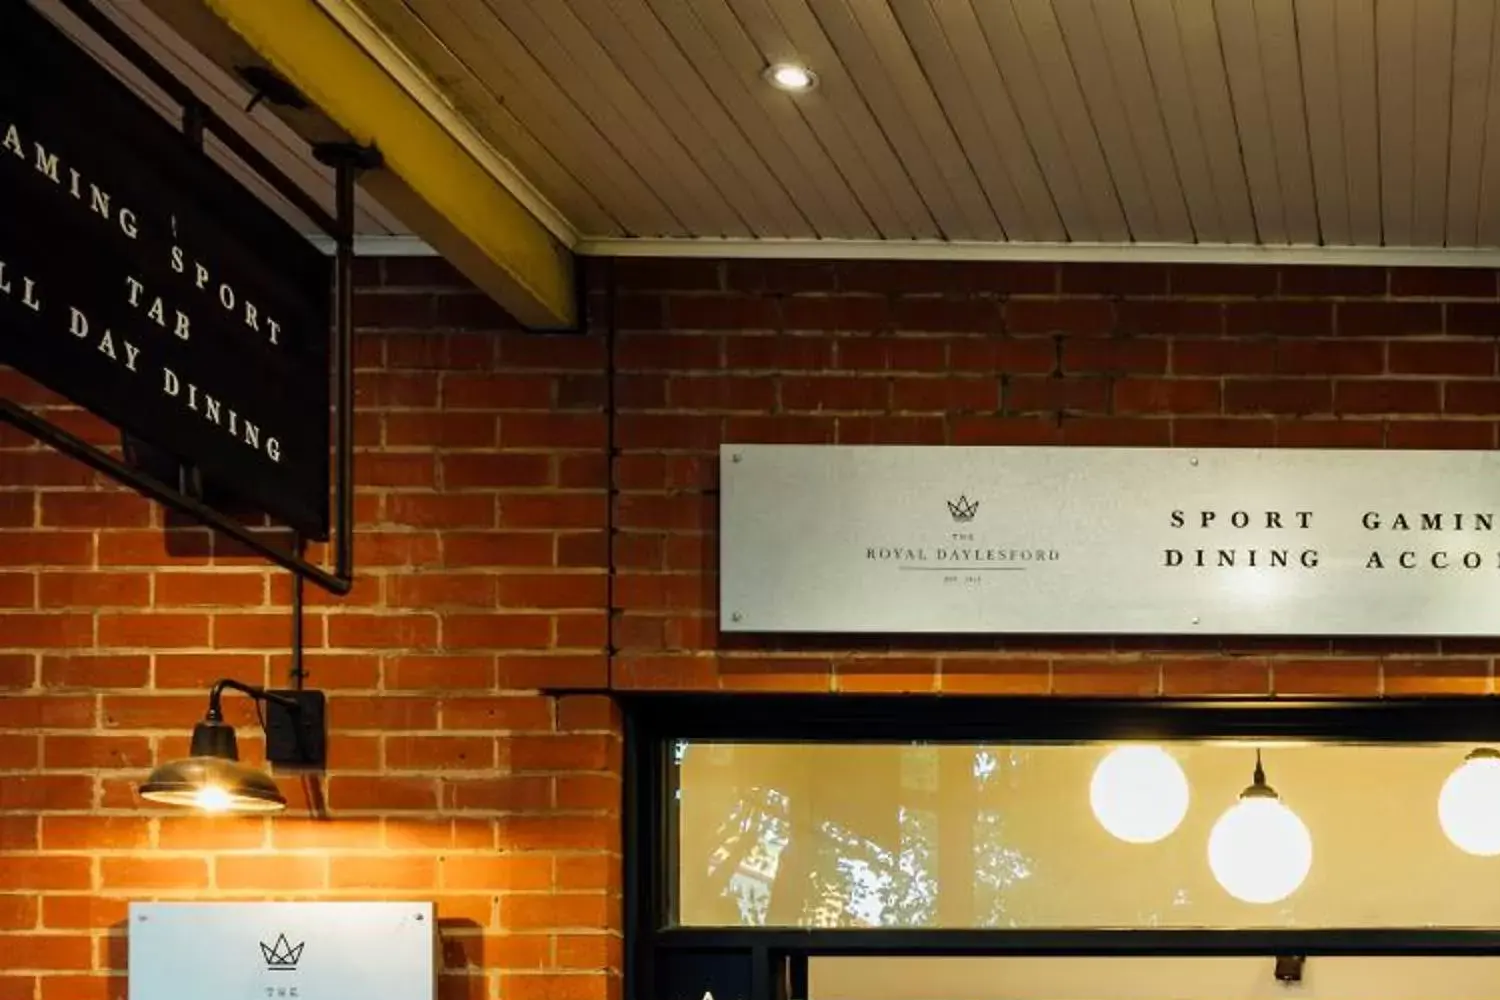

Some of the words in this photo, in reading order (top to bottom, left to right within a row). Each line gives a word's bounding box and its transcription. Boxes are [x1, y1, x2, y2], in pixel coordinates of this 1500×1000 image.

[126, 274, 191, 342] TAB
[171, 245, 282, 346] SPORT
[69, 305, 141, 373] DAY
[163, 367, 282, 463] DINING
[1170, 510, 1313, 530] SPORT
[866, 548, 927, 561] ROYAL
[937, 548, 1060, 561] DAYLESFORD
[1165, 548, 1319, 568] DINING
